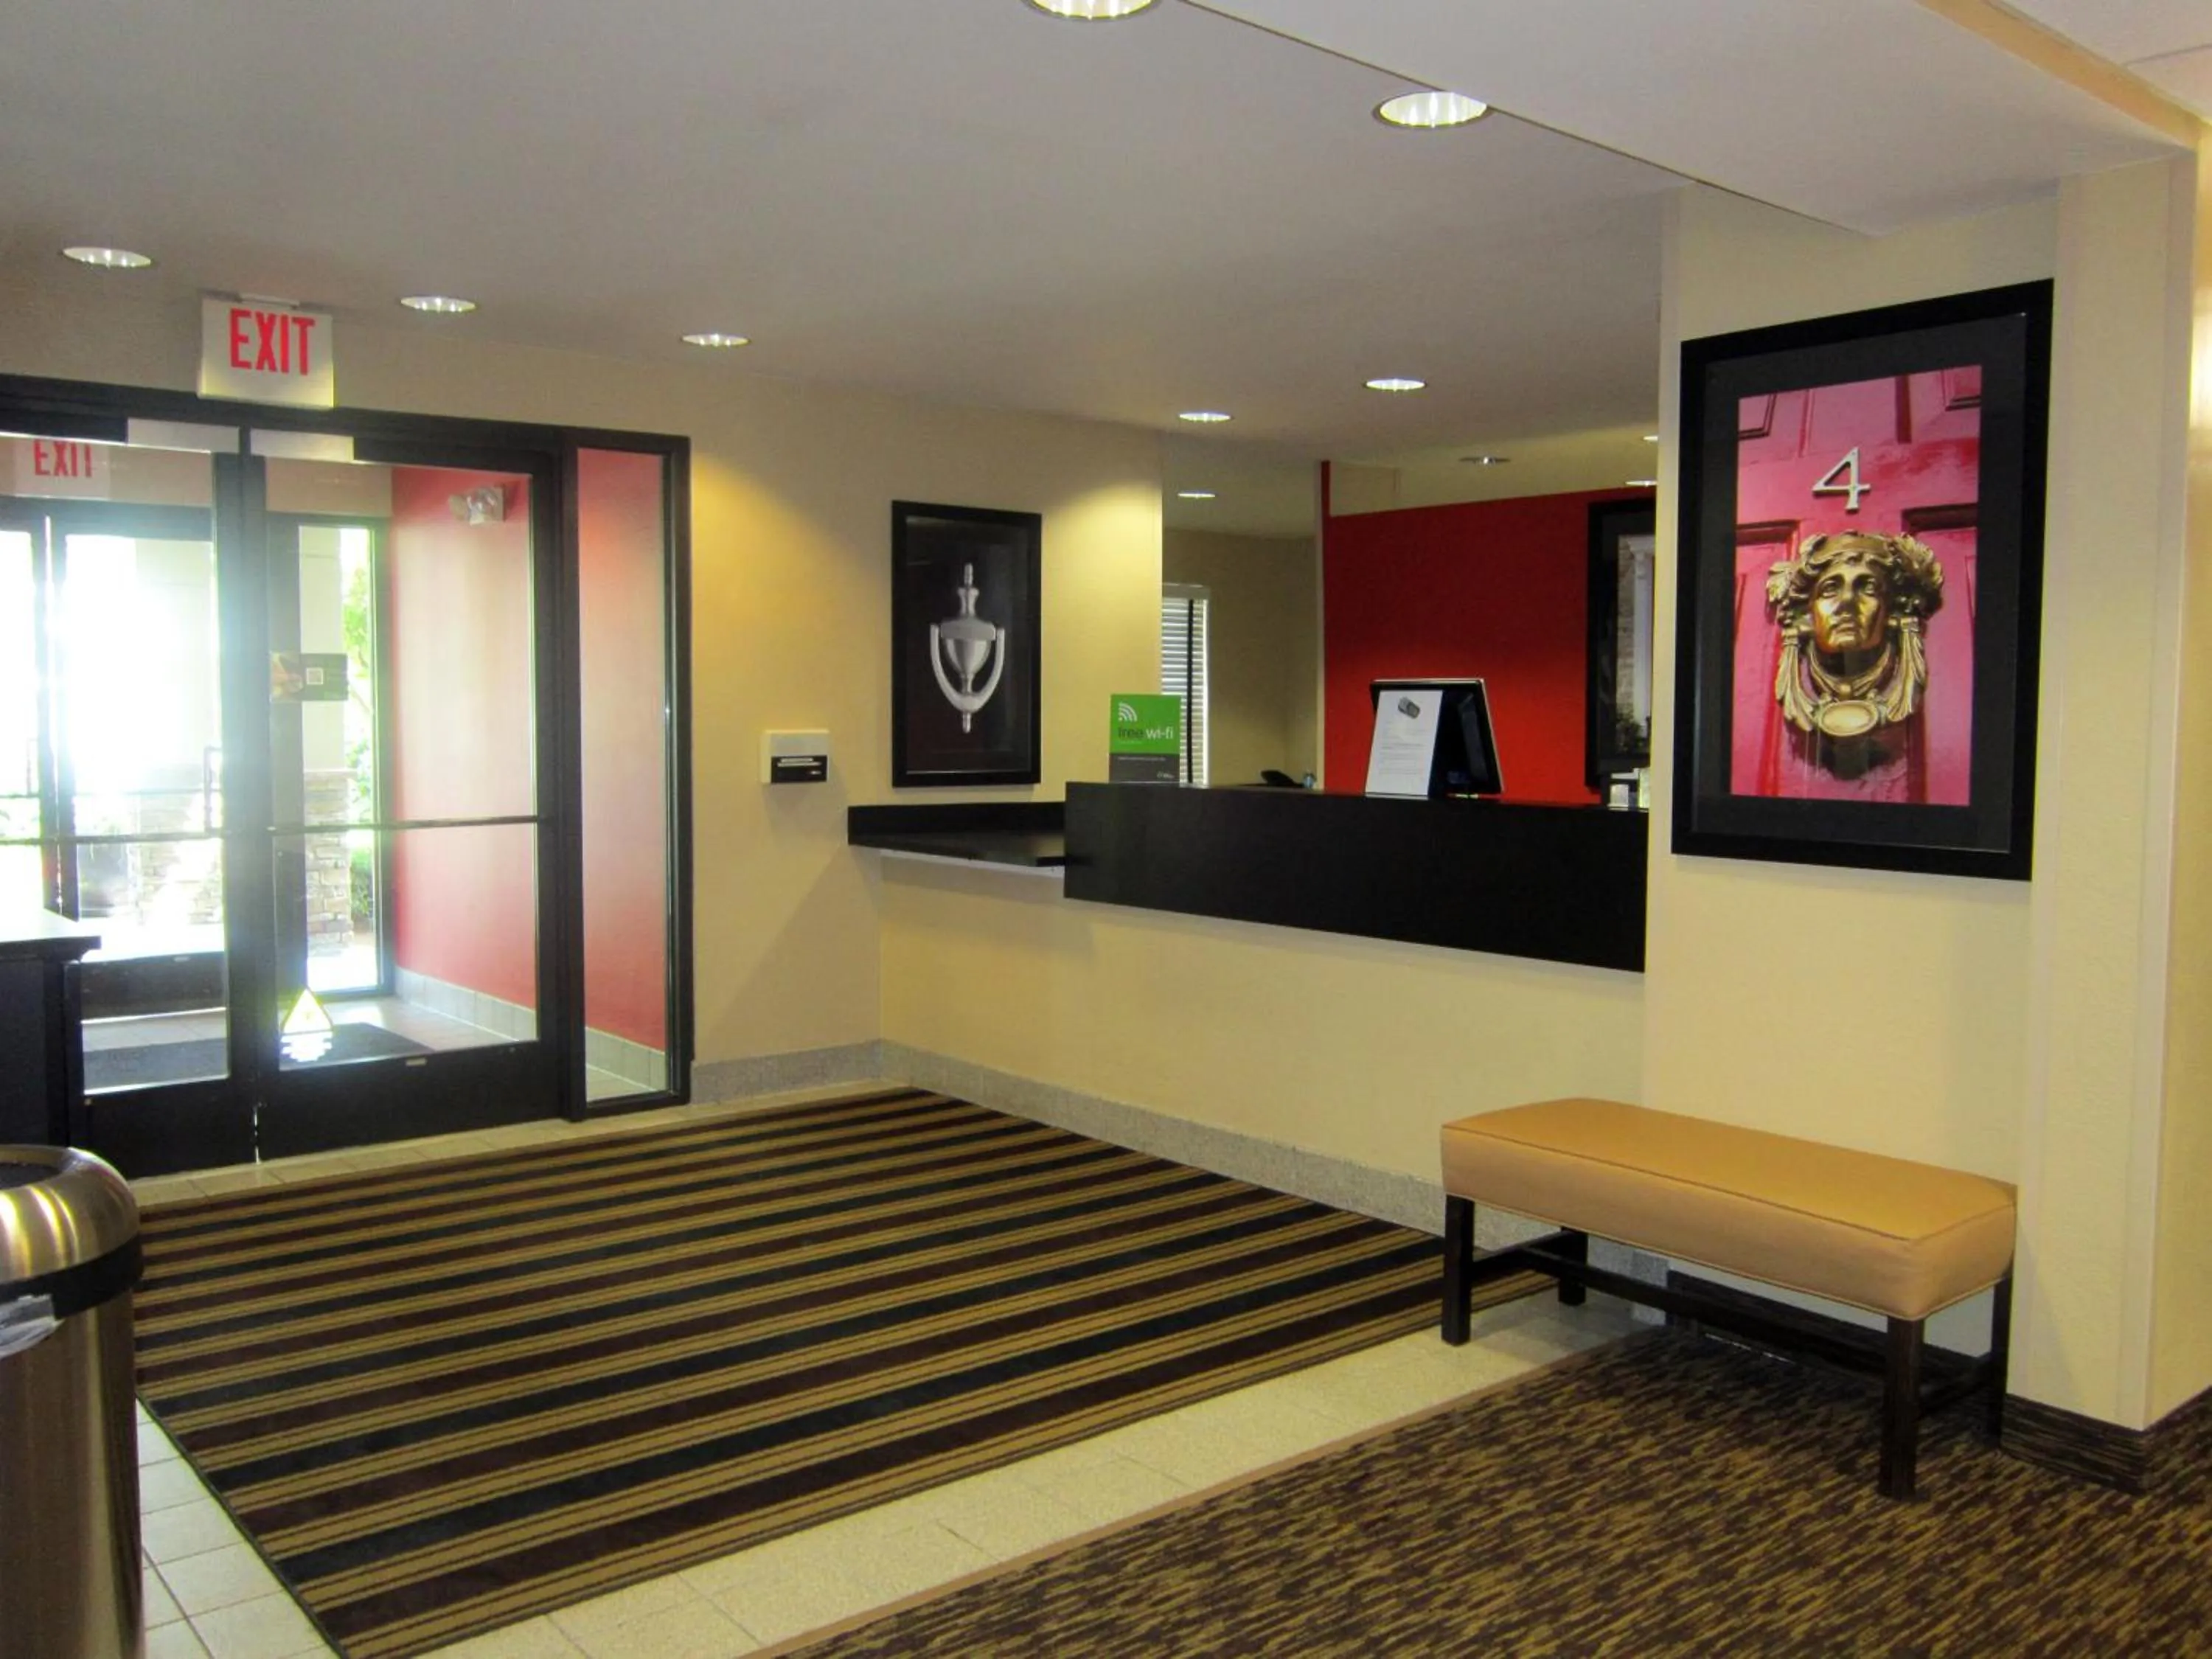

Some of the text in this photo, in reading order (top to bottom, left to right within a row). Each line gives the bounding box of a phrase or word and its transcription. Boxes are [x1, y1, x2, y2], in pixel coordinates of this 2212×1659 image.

[230, 307, 316, 376] EXIT
[1812, 446, 1871, 509] 4
[1145, 726, 1174, 740] wi-fi
